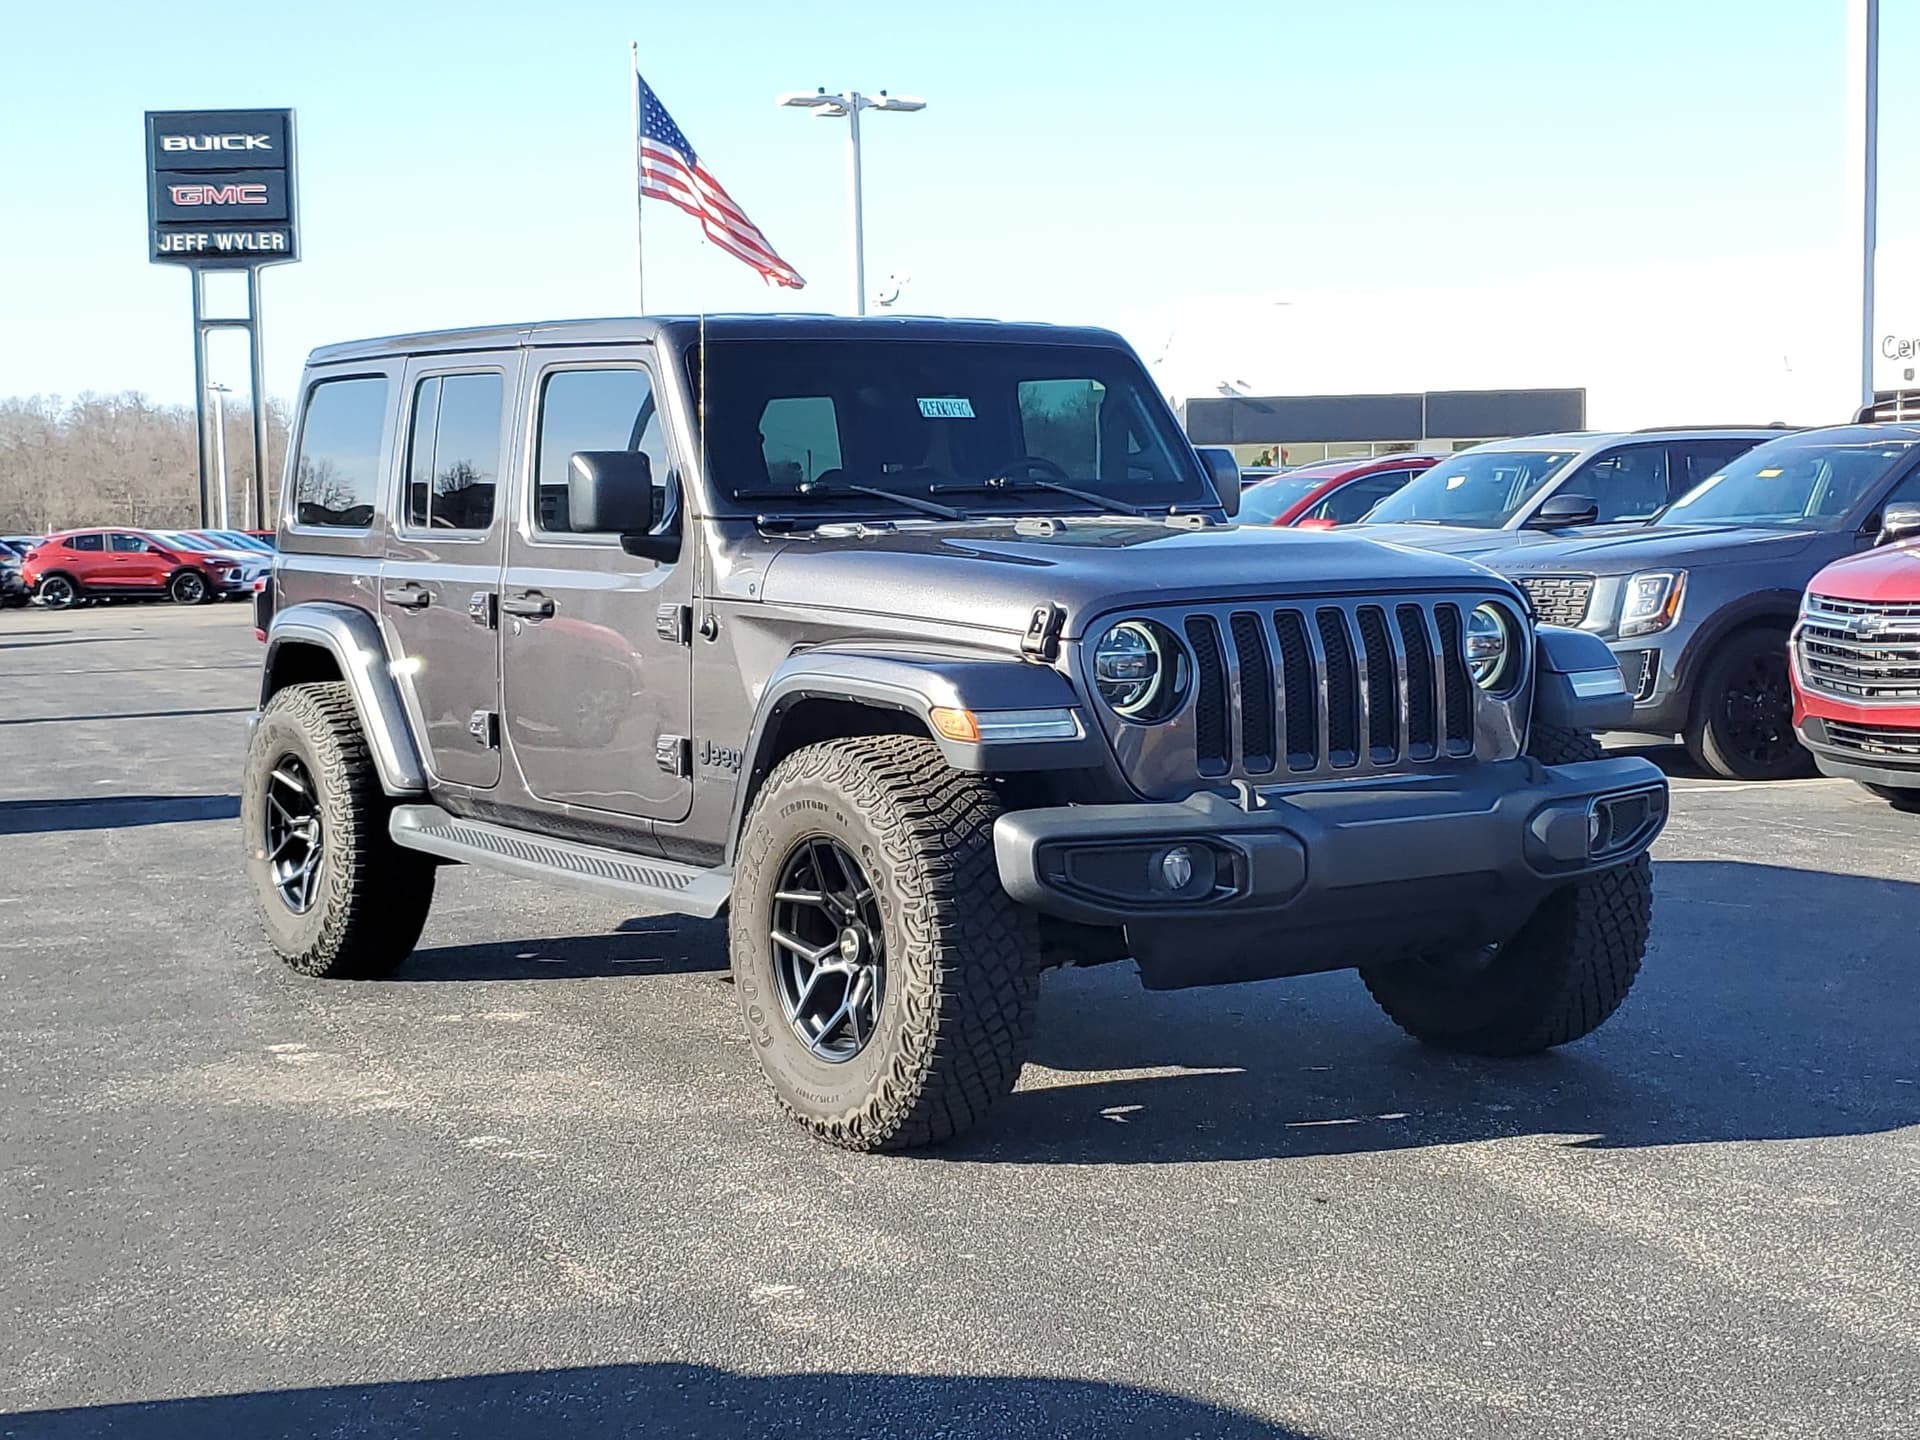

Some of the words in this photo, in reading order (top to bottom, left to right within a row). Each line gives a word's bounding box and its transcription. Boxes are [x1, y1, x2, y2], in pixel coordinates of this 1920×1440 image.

[161, 135, 272, 151] BUICK
[167, 184, 268, 206] GMC
[159, 232, 209, 251] JEFF
[213, 229, 285, 251] WYLER
[700, 739, 743, 773] Jeep
